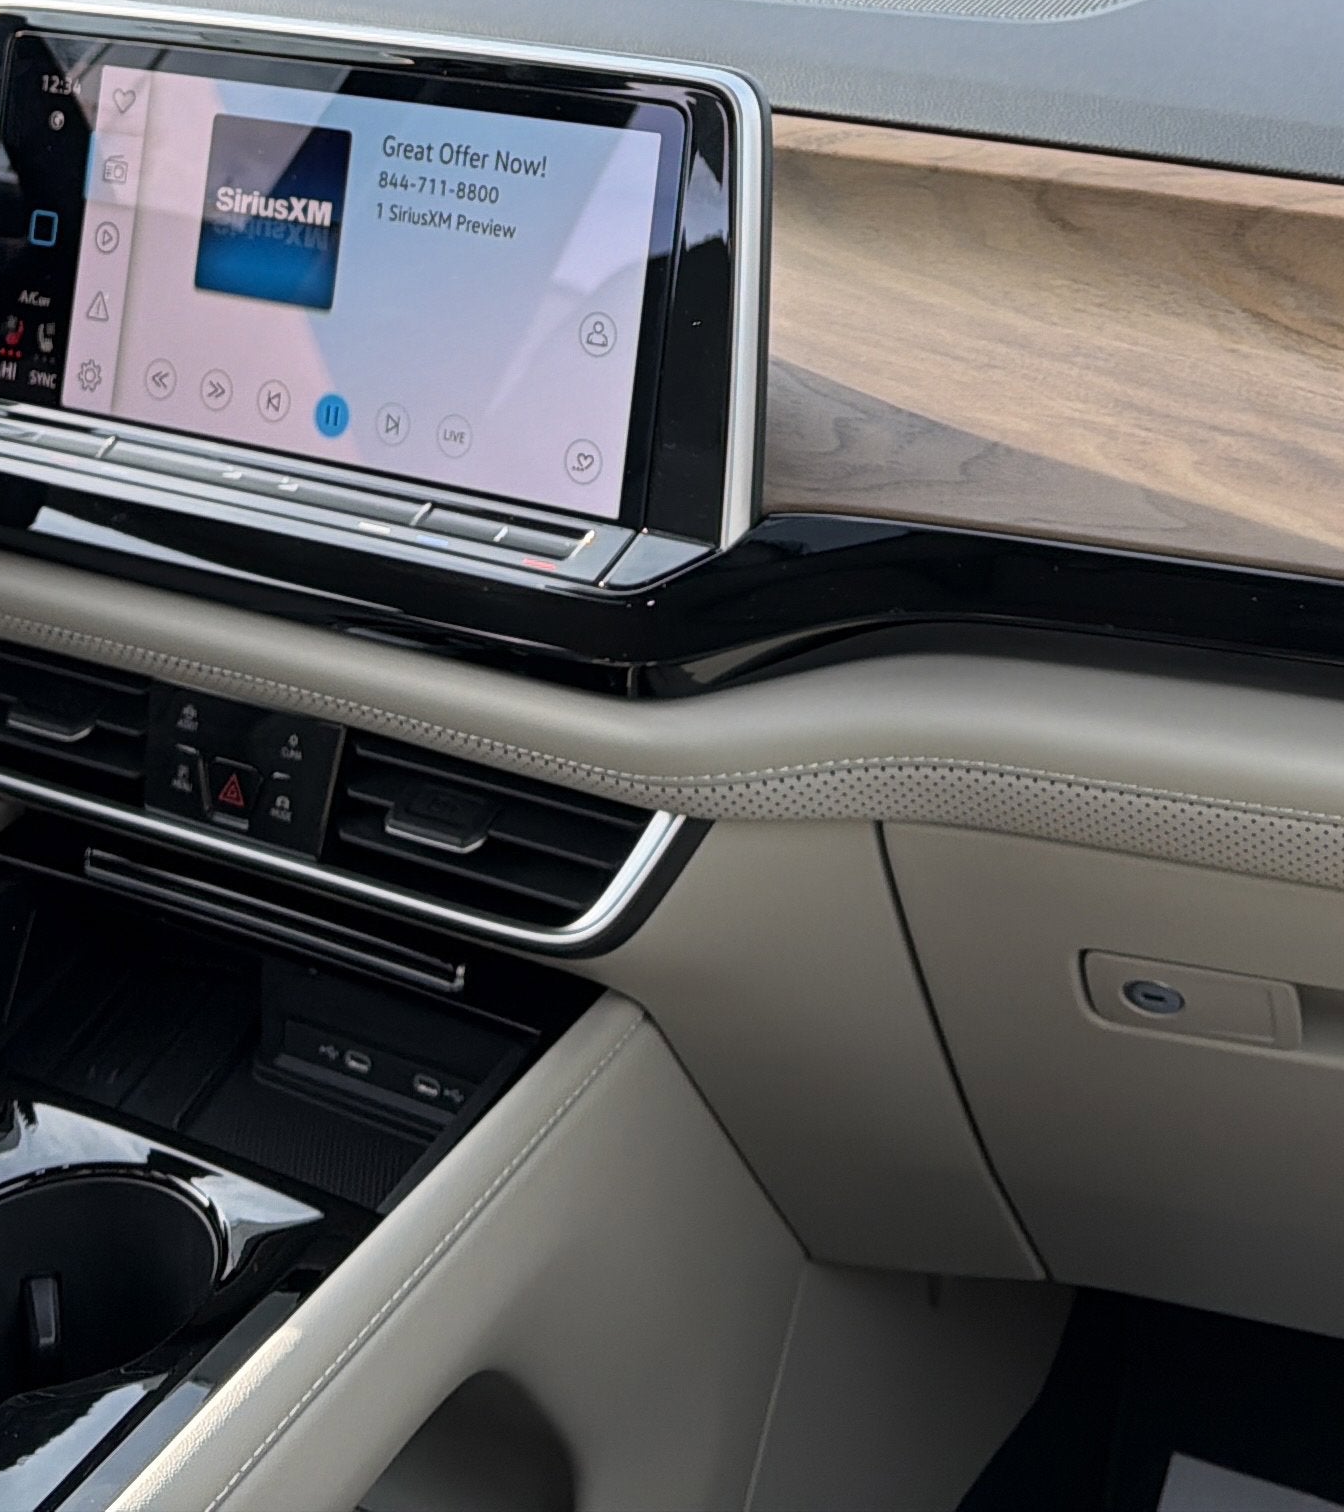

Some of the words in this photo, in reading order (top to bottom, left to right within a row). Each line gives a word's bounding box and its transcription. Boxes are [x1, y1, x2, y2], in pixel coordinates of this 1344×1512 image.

[42, 74, 81, 96] 12:34
[382, 134, 435, 163] Great
[439, 142, 490, 170] Offer
[494, 149, 548, 178] Now!
[378, 170, 500, 204] 844-711-8800
[215, 186, 333, 227] SiriusXM
[376, 202, 384, 219] 1
[388, 203, 452, 230] SiriusXM
[456, 214, 517, 239] Preview
[0, 360, 17, 381] HI
[28, 369, 58, 390] SYNC
[443, 428, 466, 444] LIVE
